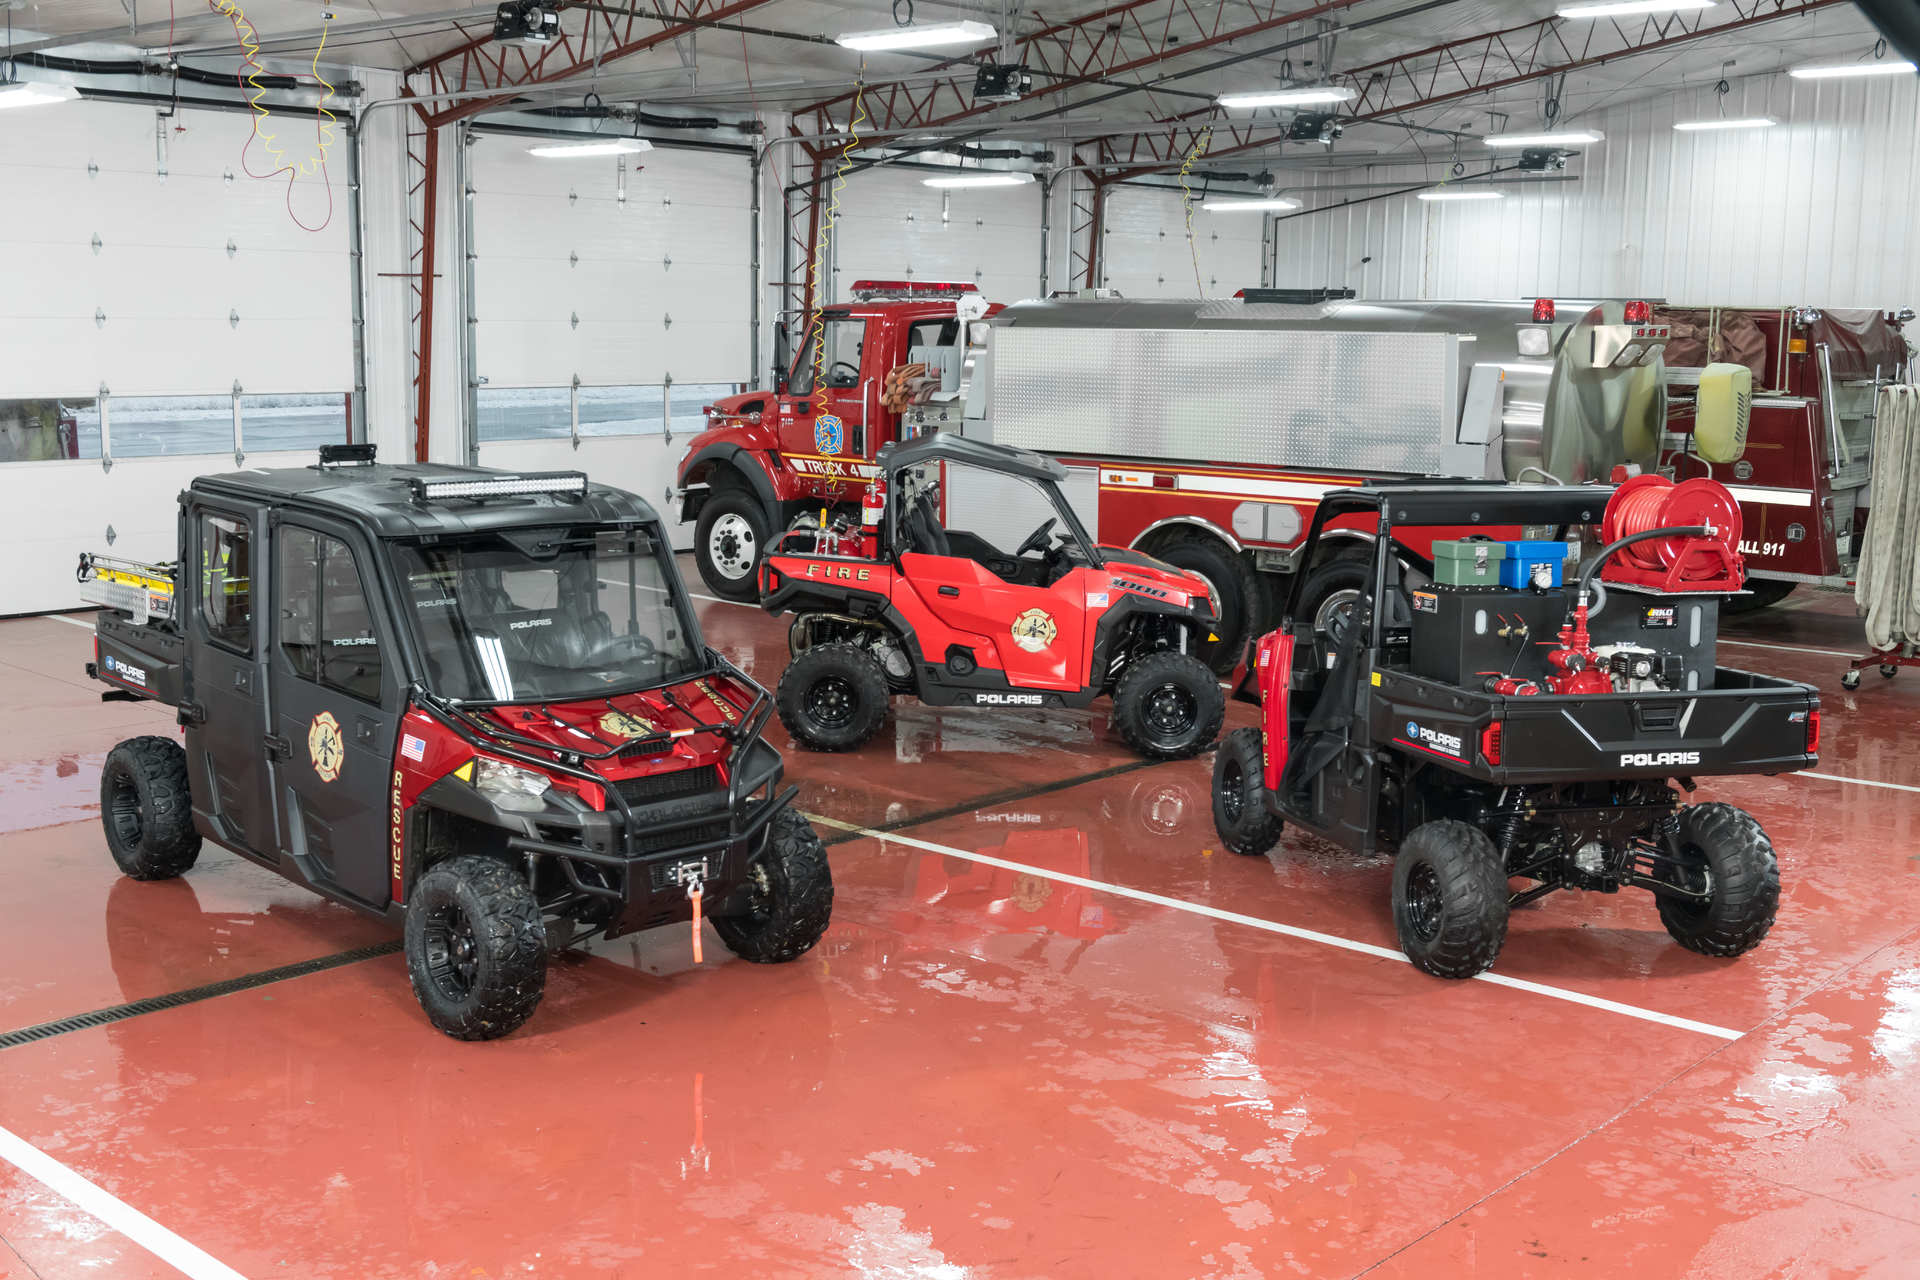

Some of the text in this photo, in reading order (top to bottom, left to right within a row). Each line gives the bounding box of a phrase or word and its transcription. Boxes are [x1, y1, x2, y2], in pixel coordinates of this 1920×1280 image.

[804, 460, 859, 477] TRUCK 4
[1736, 540, 1785, 556] ALL 911
[806, 564, 870, 581] FIRE
[1110, 578, 1168, 598] 1000
[417, 598, 457, 608] POLARIS
[510, 618, 552, 630] POLARIS
[115, 660, 146, 680] POLARIS
[694, 681, 737, 720] RESCUE
[976, 694, 1043, 704] POLARIS
[1420, 727, 1461, 748] POLARIS
[1620, 752, 1700, 767] POLARIS
[392, 770, 403, 880] RESCUE
